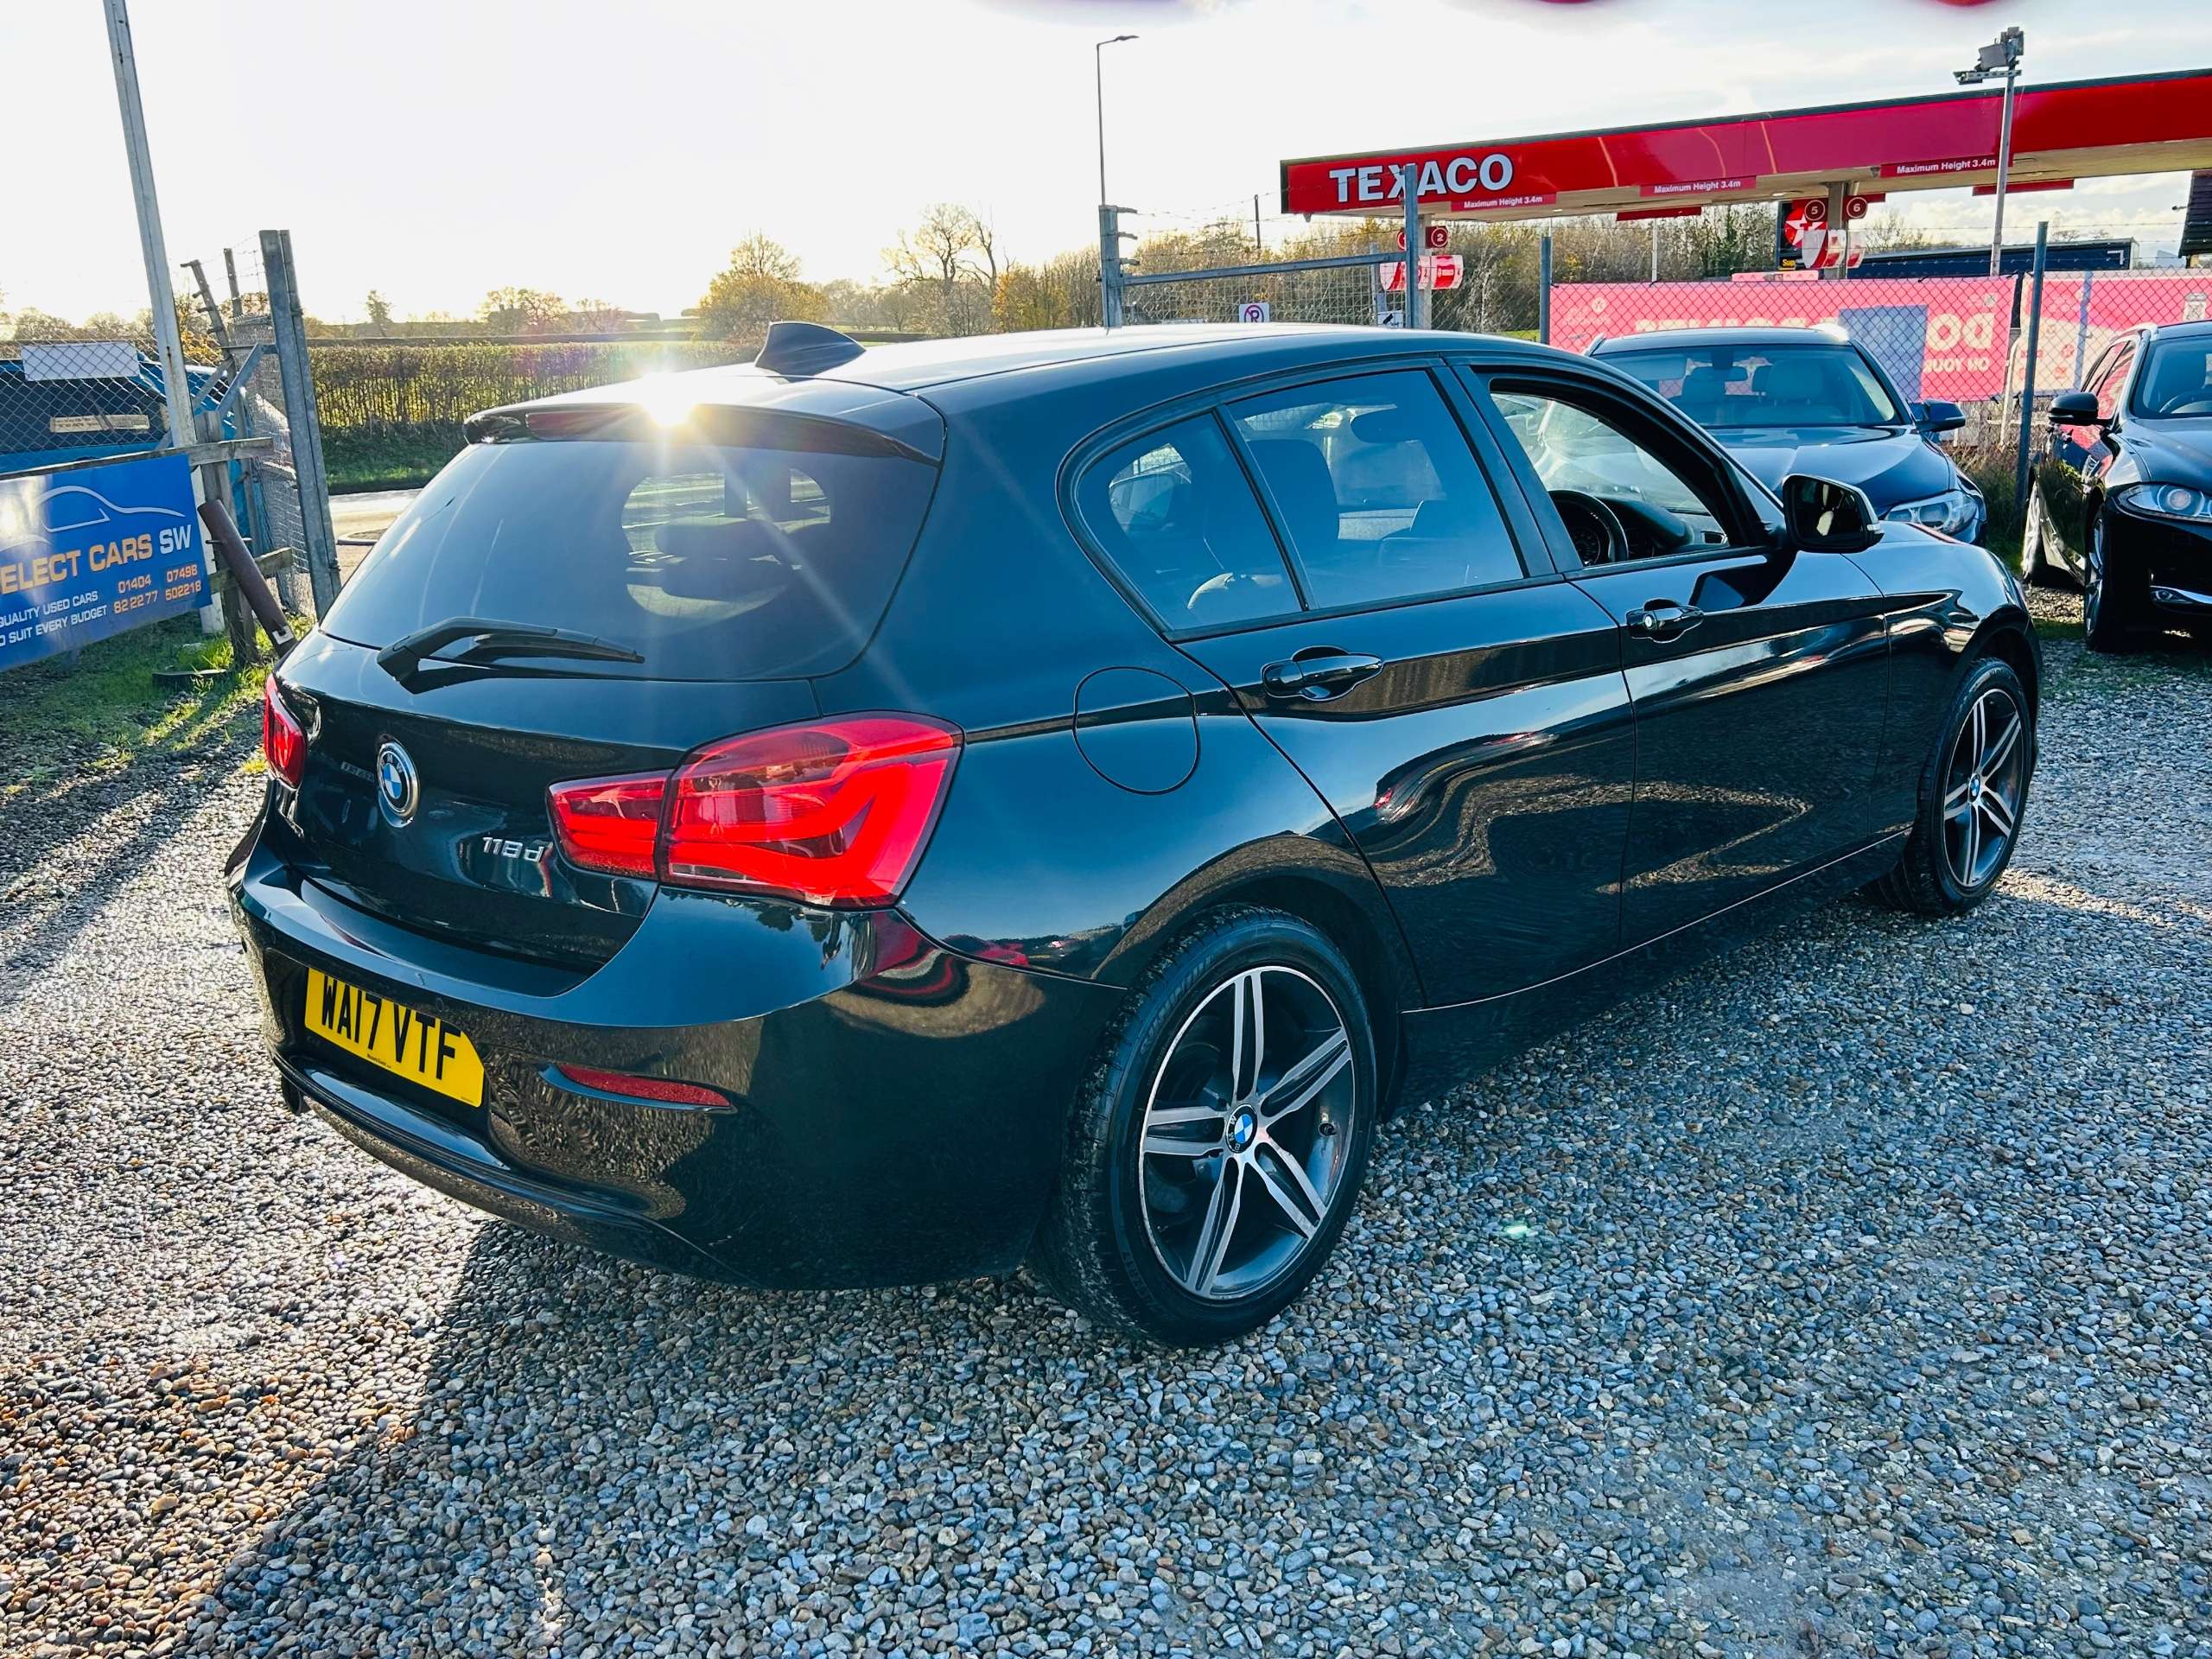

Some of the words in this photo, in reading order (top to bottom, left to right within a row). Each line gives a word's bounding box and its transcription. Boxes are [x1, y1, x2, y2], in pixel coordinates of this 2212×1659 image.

[1896, 162, 1939, 175] Maximum
[1941, 160, 1970, 173] Height
[1972, 157, 1996, 168] 3.4m
[1329, 153, 1513, 202] TEXACO
[1654, 182, 1691, 194] Maximum
[1693, 181, 1719, 192] Height
[1720, 179, 1741, 188] 3.4m
[1464, 199, 1497, 209] Maximum
[1499, 197, 1522, 207] Height
[1524, 195, 1542, 204] 3.4m
[1853, 204, 1860, 213] 6
[0, 549, 81, 595] ELECT
[89, 533, 153, 572] CARS
[159, 524, 192, 555] SW
[118, 574, 152, 594] 01404
[166, 564, 198, 582] 07498
[43, 598, 70, 615] USED
[73, 590, 99, 607] CARS
[9, 626, 33, 644] SUIT
[35, 616, 68, 636] EVERY
[70, 605, 108, 626] BUDGET
[483, 836, 545, 863] 118d
[321, 975, 383, 1051] WA17
[393, 1002, 462, 1081] VTF
